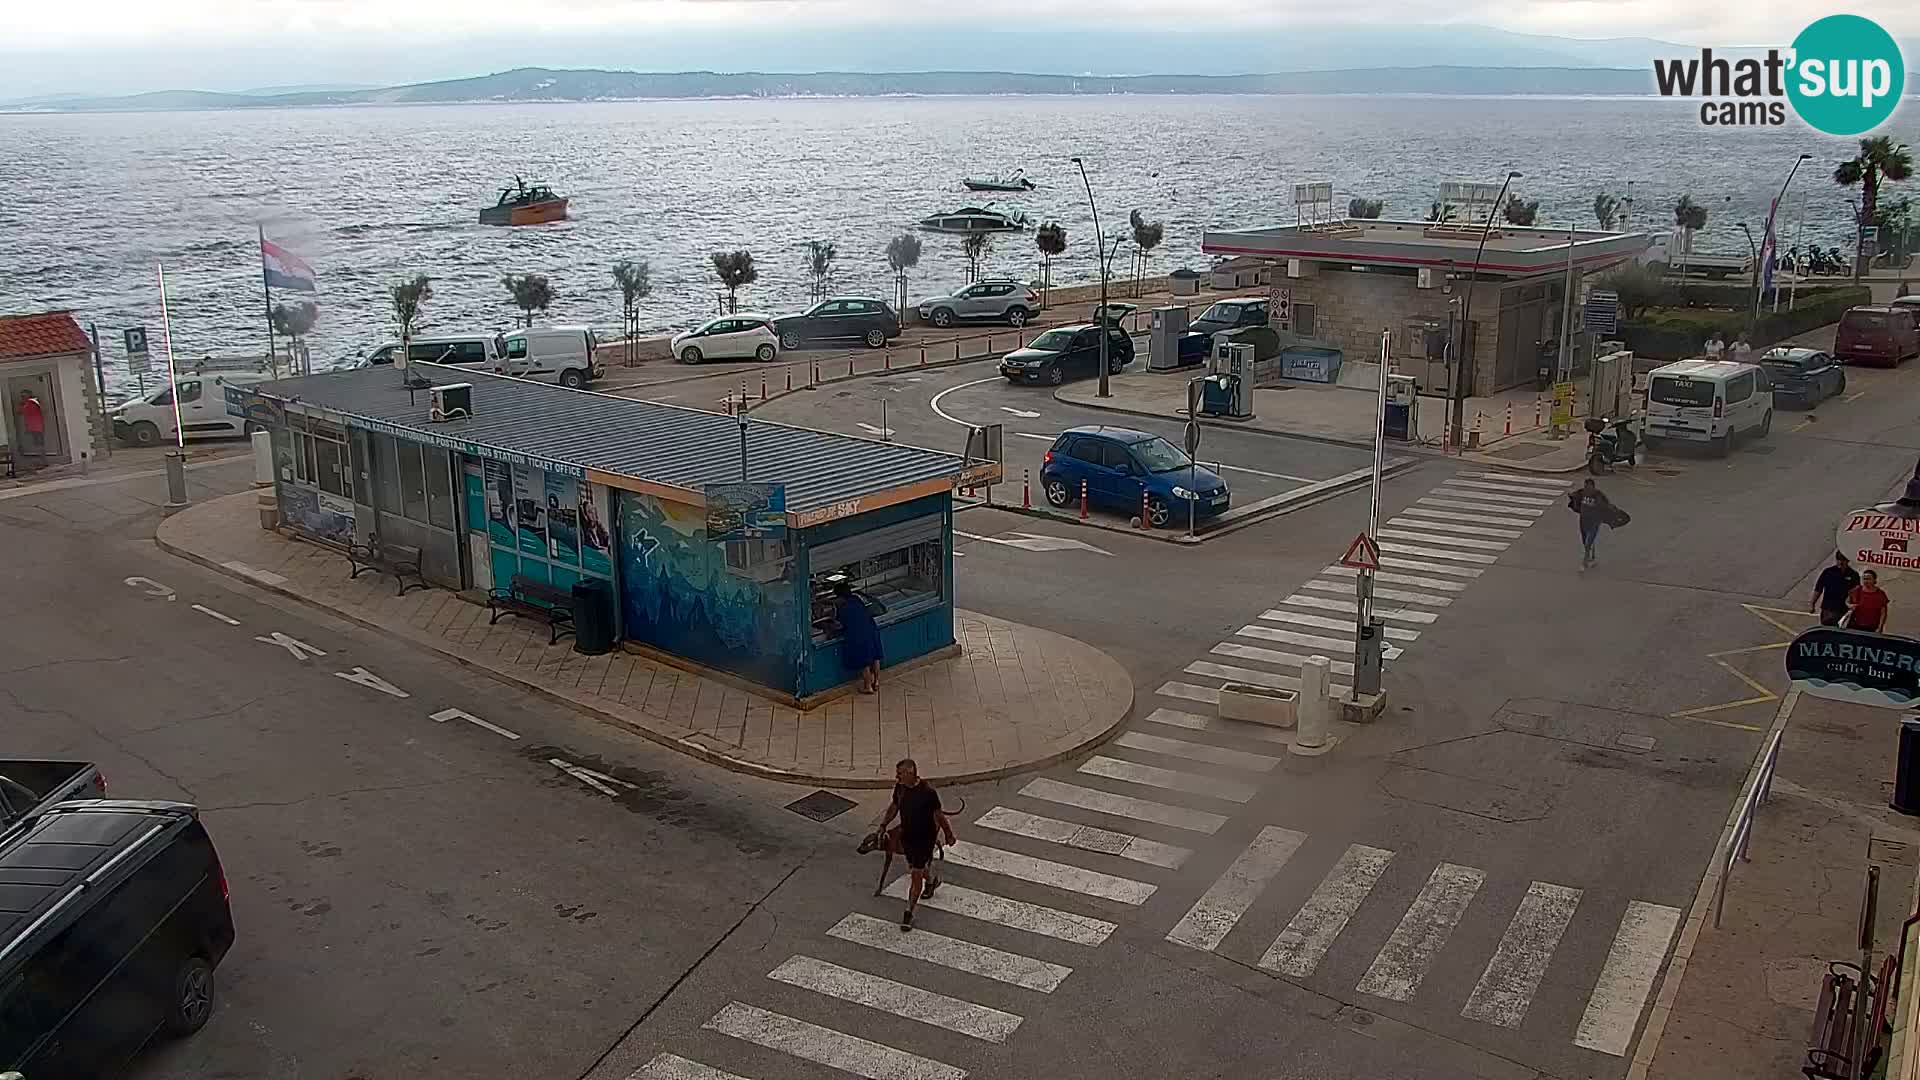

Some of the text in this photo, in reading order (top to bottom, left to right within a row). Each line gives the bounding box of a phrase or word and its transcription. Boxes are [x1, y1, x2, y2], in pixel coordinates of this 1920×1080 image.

[129, 331, 142, 349] P
[1674, 380, 1693, 389] TAXI
[435, 436, 467, 451] POSTAJA
[477, 445, 492, 457] BUS
[493, 449, 526, 465] STATION
[527, 456, 554, 471] TICKET
[554, 463, 582, 477] OFFICE
[1846, 514, 1920, 534] PIZZE
[1880, 530, 1915, 541] GRILL
[1826, 662, 1895, 680] caffe bar
